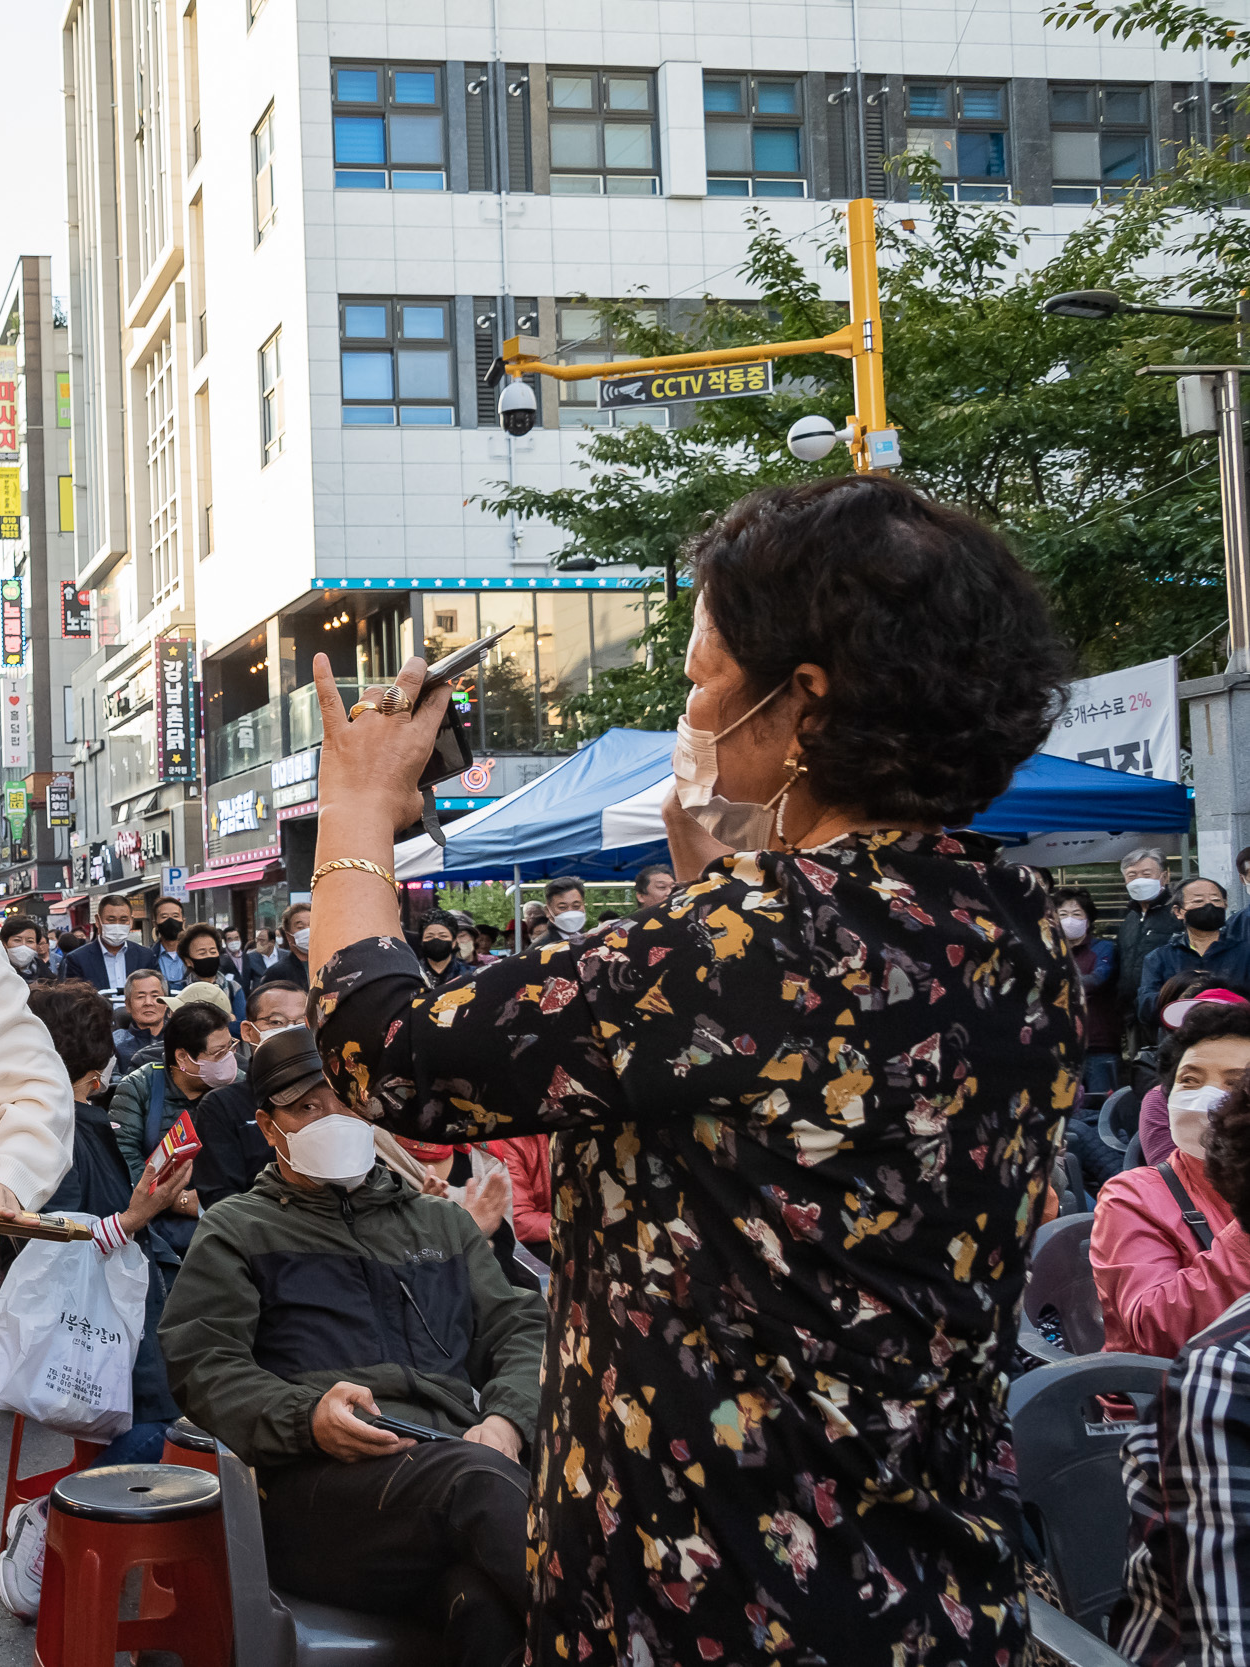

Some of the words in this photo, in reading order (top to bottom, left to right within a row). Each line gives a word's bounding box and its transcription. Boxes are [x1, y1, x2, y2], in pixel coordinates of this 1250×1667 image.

[651, 374, 703, 399] CCTV
[708, 366, 766, 393] 작동중
[1129, 692, 1152, 712] 2%
[169, 868, 181, 885] P
